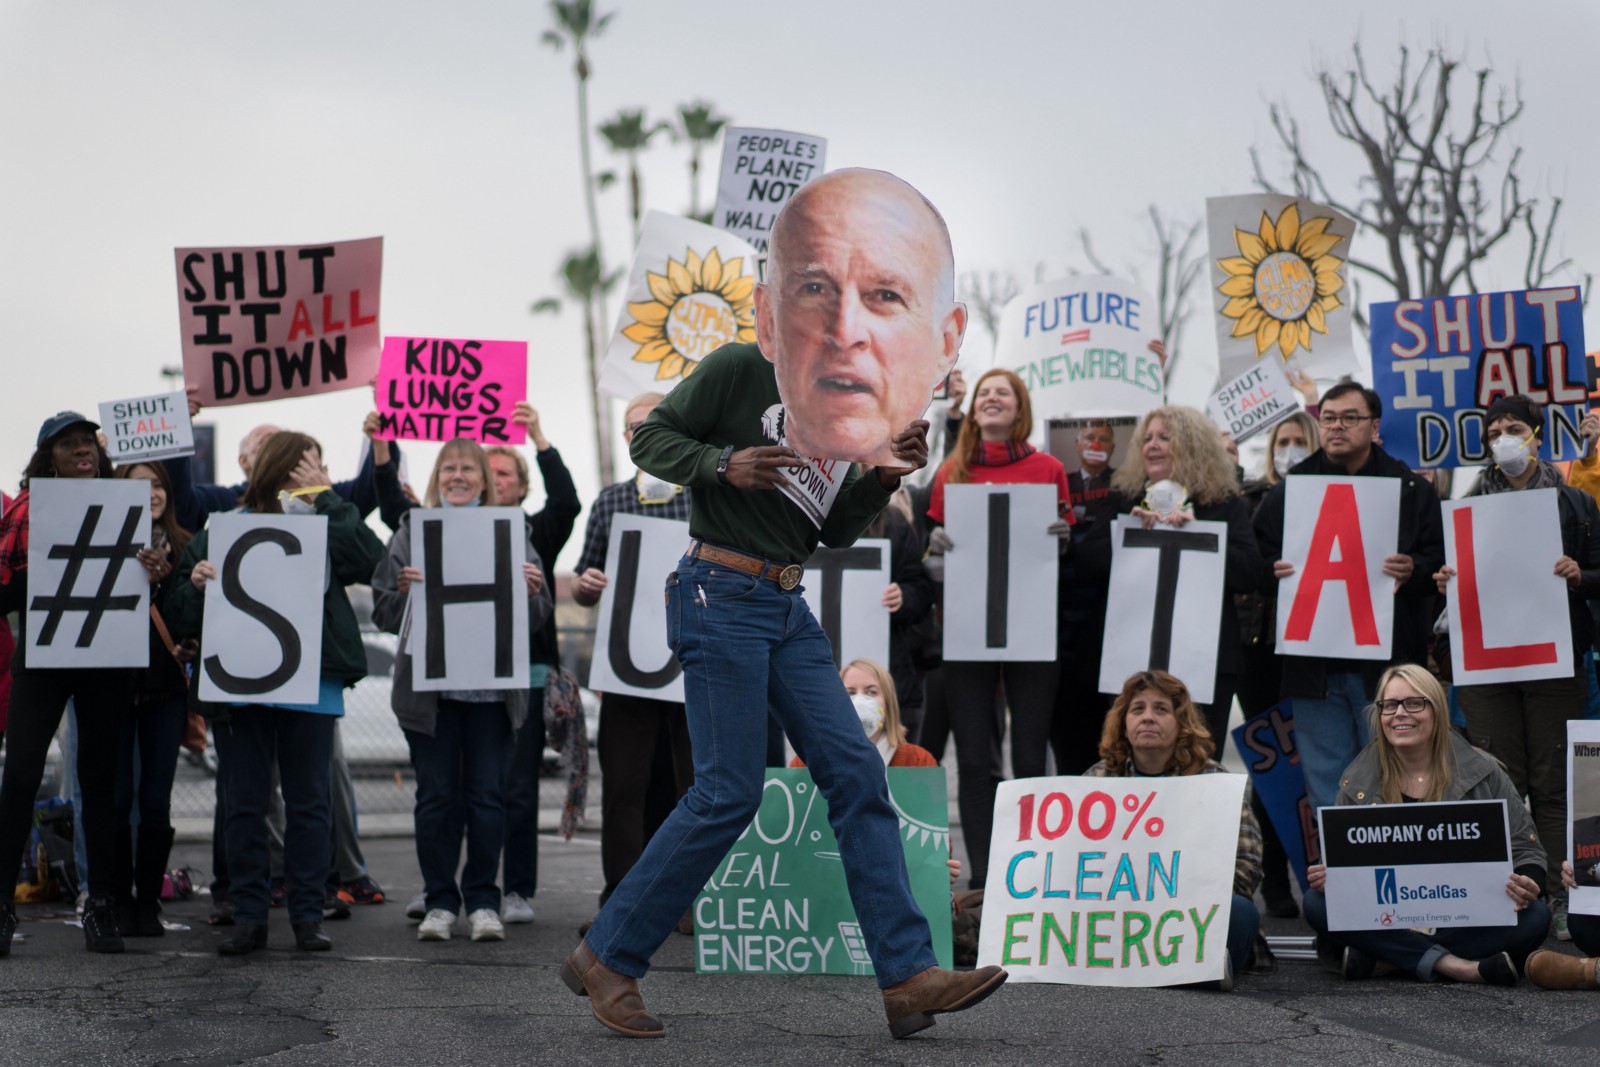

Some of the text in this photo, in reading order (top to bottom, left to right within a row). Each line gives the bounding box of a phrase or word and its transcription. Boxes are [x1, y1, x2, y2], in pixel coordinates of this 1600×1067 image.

[737, 135, 819, 160] PEOPLE'S
[735, 156, 816, 183] PLANET
[748, 178, 800, 203] NOT
[182, 246, 335, 301] SHUT
[193, 289, 377, 345] IT ALL
[1024, 291, 1141, 338] FUTURE
[1391, 288, 1578, 359] SHUT
[212, 335, 348, 400] DOWN
[405, 339, 483, 382] KIDS
[1014, 348, 1162, 395] NEWABLES
[1392, 356, 1470, 410] IT
[1475, 342, 1588, 409] ALL
[388, 378, 502, 415] LUNGS
[1218, 367, 1269, 406] SHUT.
[113, 397, 174, 419] SHUT.
[379, 411, 511, 442] MATTER
[1230, 397, 1284, 434] DOWN.
[118, 432, 179, 453] DOWN.
[1416, 404, 1590, 467] DON
[1016, 790, 1165, 842] 100%
[1347, 822, 1481, 844] COMPANY of LIES
[1005, 850, 1181, 901] CLEAN
[1400, 884, 1468, 901] SoCalGas
[696, 897, 809, 932] CLEAN
[1396, 914, 1425, 925] Sempra
[1426, 913, 1453, 924] Energy
[698, 934, 835, 974] ENERGY
[1001, 904, 1221, 968] ENERGY
